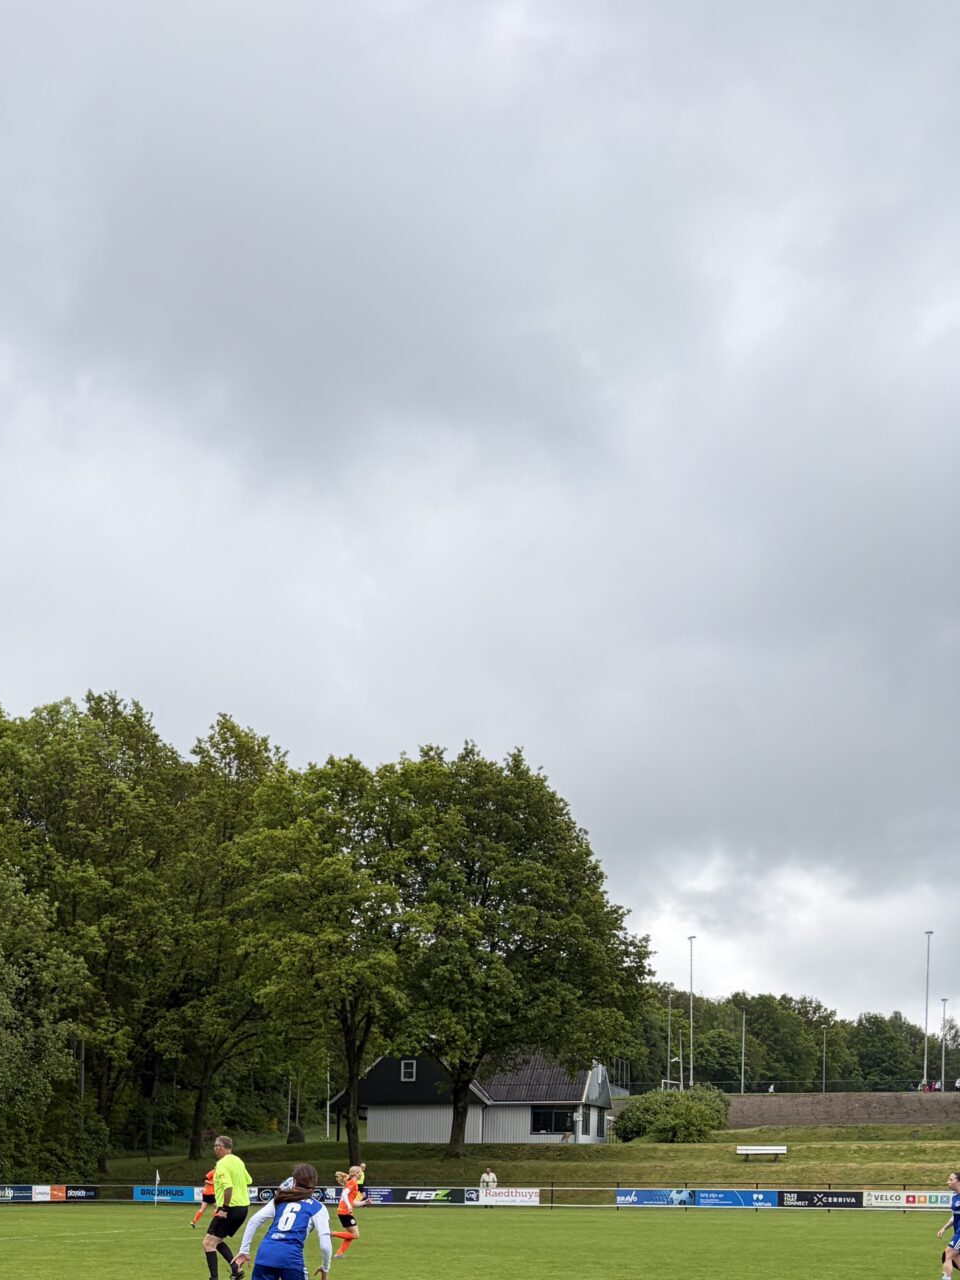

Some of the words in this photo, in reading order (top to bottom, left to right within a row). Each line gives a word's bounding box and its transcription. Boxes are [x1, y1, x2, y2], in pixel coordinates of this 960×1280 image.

[141, 1188, 184, 1197] BROOKHUIS
[617, 1191, 638, 1203] BRAVO
[277, 1202, 302, 1231] 6
